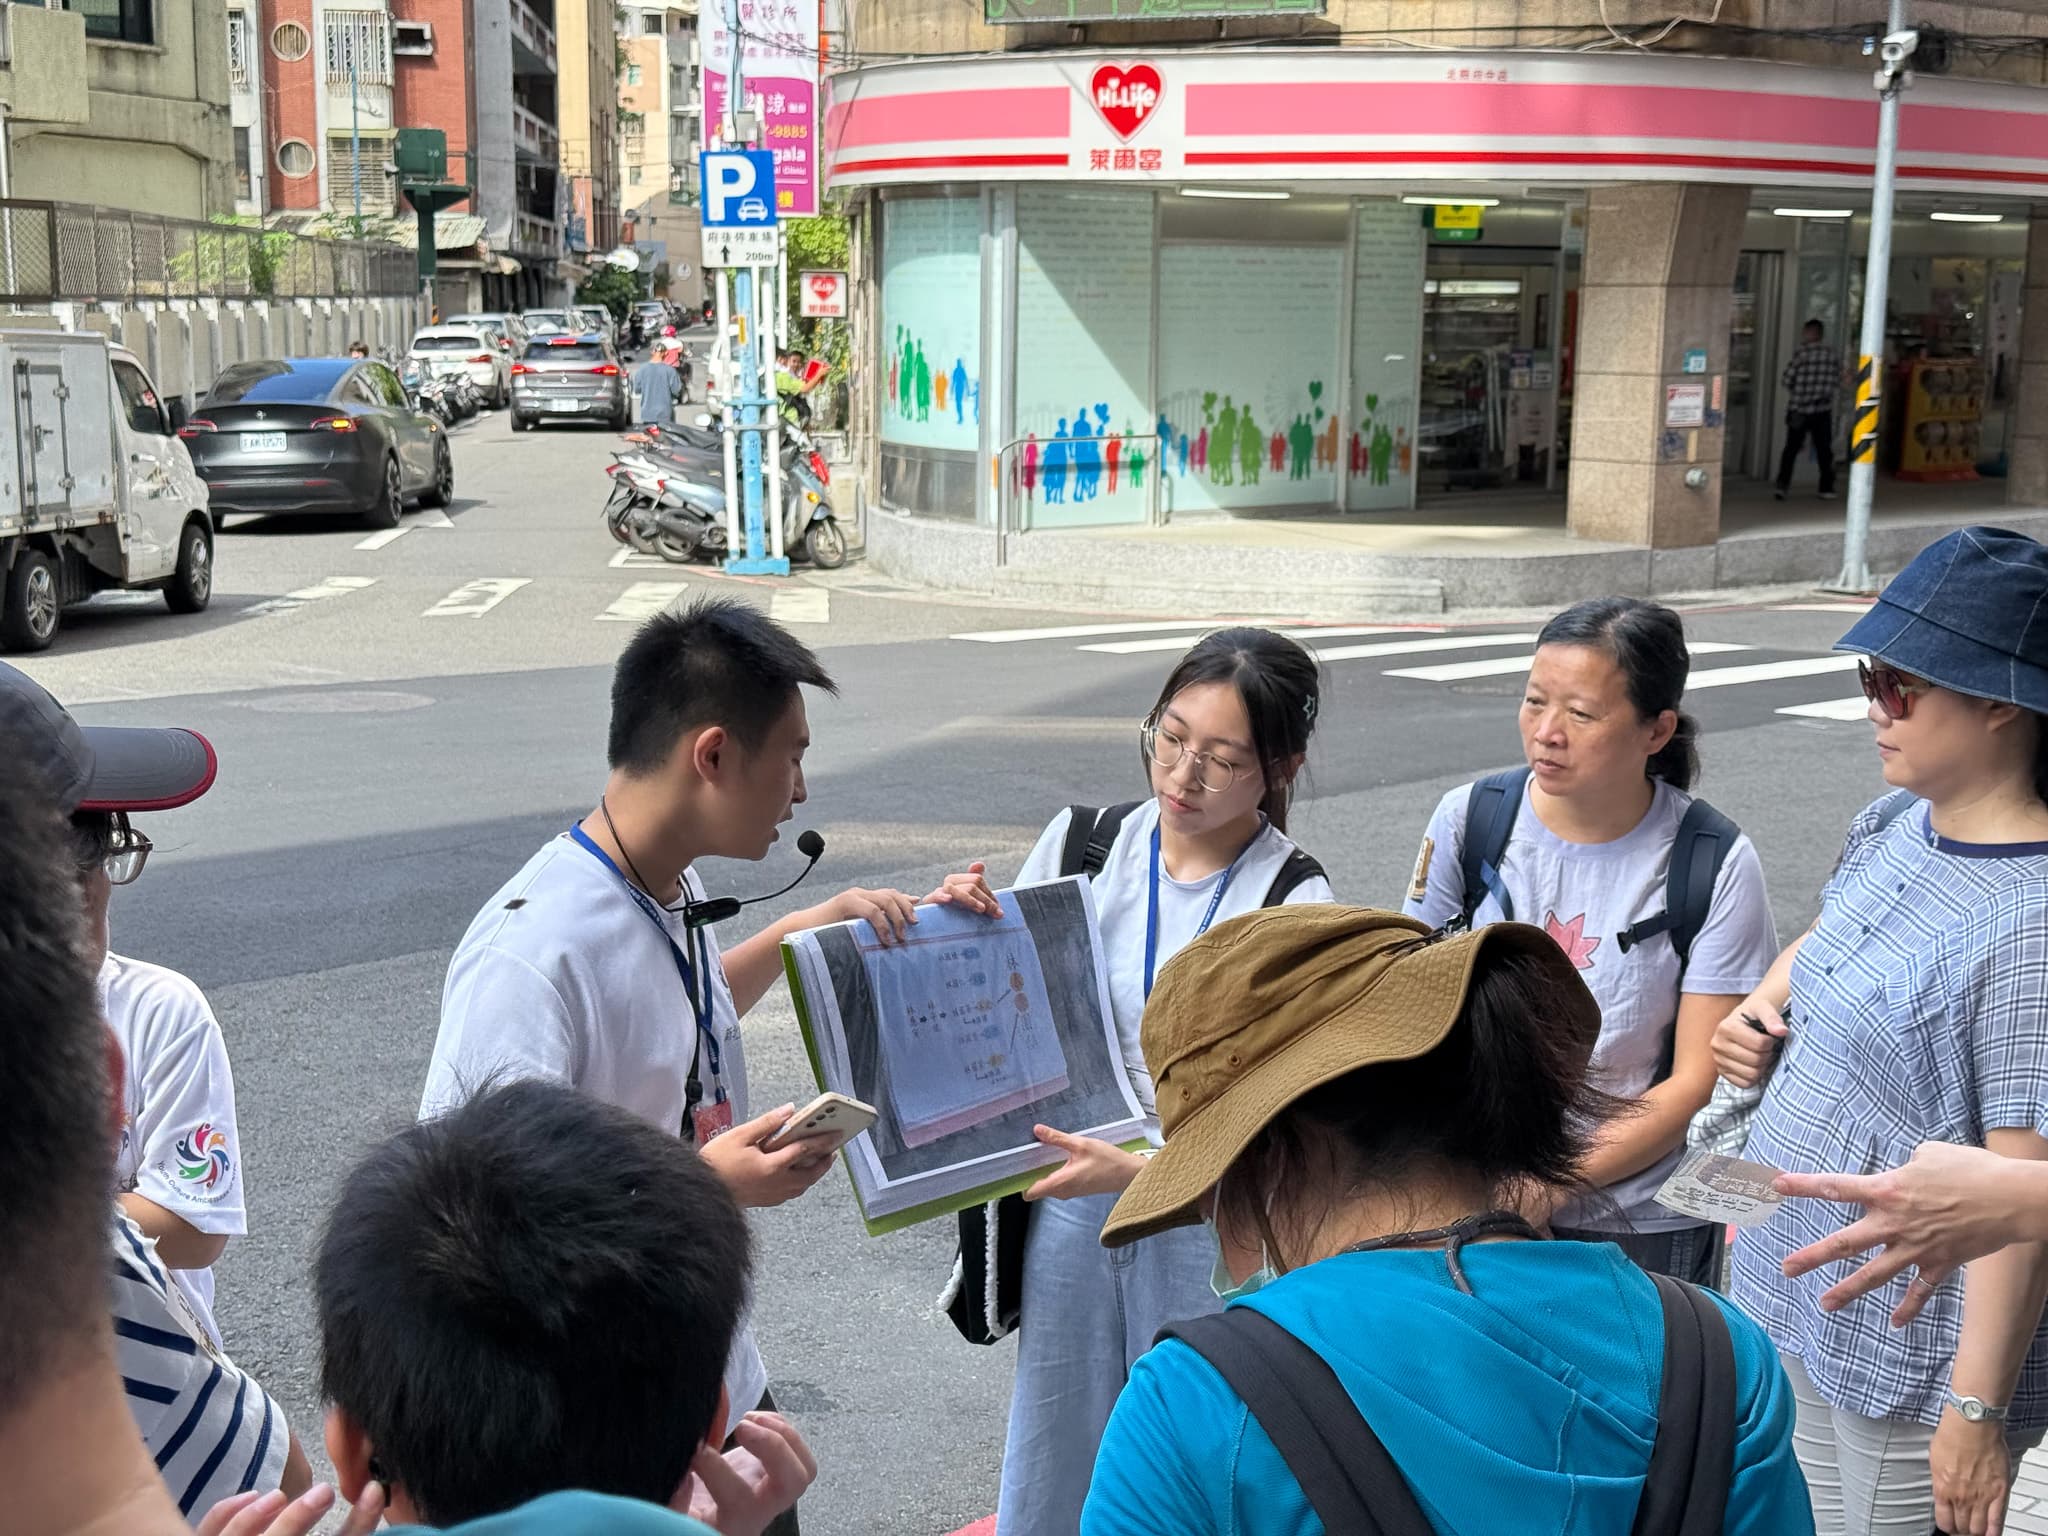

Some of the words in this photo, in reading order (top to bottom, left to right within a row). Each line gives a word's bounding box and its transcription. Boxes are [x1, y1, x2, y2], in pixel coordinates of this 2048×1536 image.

[1090, 148, 1162, 171] 萊爾富
[705, 154, 757, 222] P
[745, 251, 774, 262] 200m
